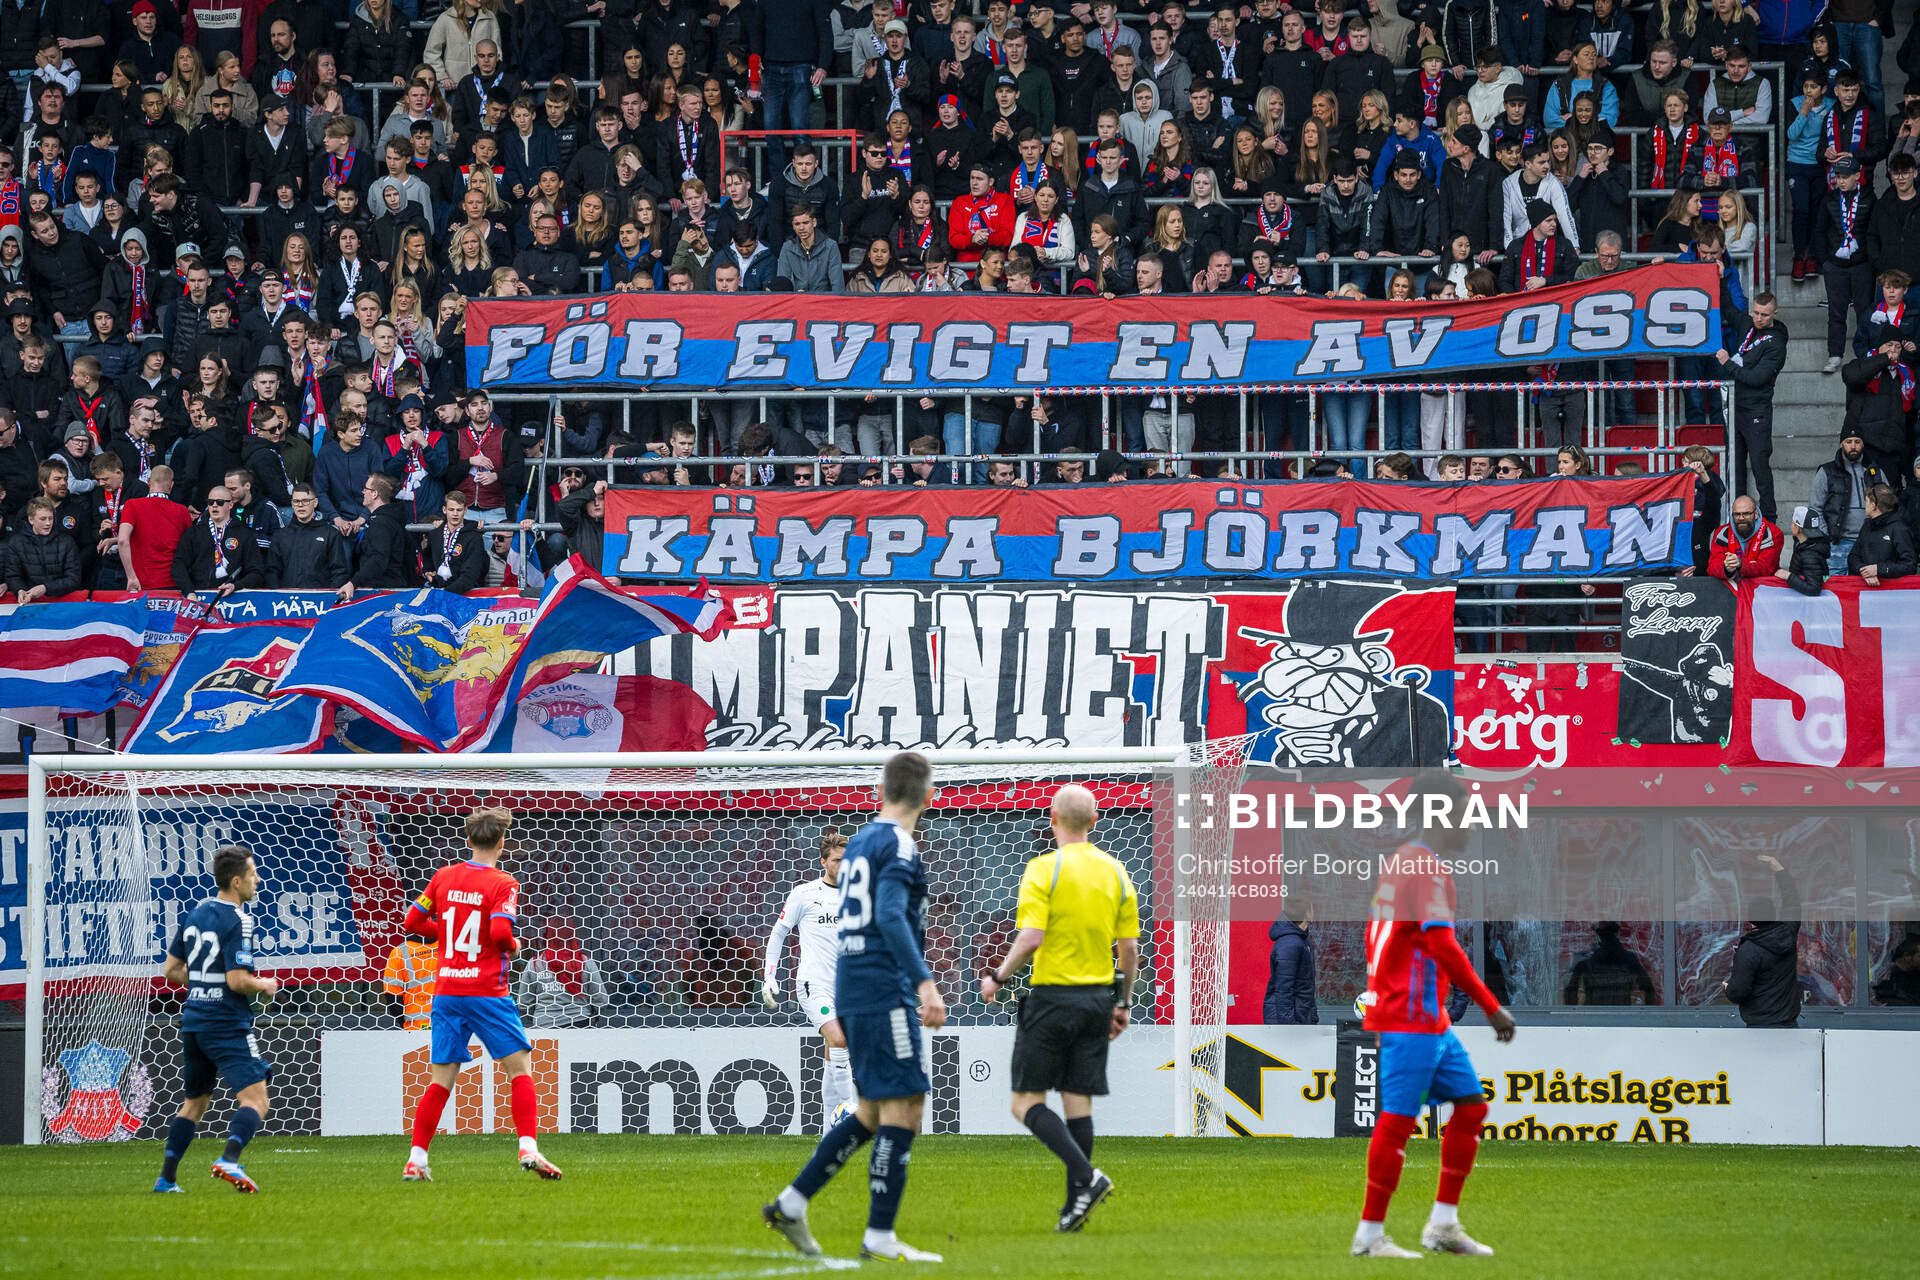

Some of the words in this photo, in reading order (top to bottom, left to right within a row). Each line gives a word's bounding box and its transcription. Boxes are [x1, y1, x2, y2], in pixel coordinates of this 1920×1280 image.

[481, 302, 684, 386] FÖR
[727, 318, 1074, 385] EVIGT
[1108, 320, 1257, 382] EN
[1295, 315, 1454, 377] AV
[1496, 287, 1714, 359] OSS
[617, 494, 1002, 579] KÄMPA
[1050, 488, 1683, 580] BJÖRKMAN
[272, 596, 329, 617] KÄRL
[1625, 576, 1696, 611] Free
[1627, 607, 1723, 642] Larry
[613, 592, 1208, 748] MPANIET
[447, 889, 484, 906] KJELLNÄS
[183, 925, 226, 982] 22
[442, 906, 482, 962] 14
[1353, 1046, 1377, 1128] SELECT
[1503, 1068, 1731, 1115] Plåtslageri
[1631, 1117, 1693, 1143] AB
